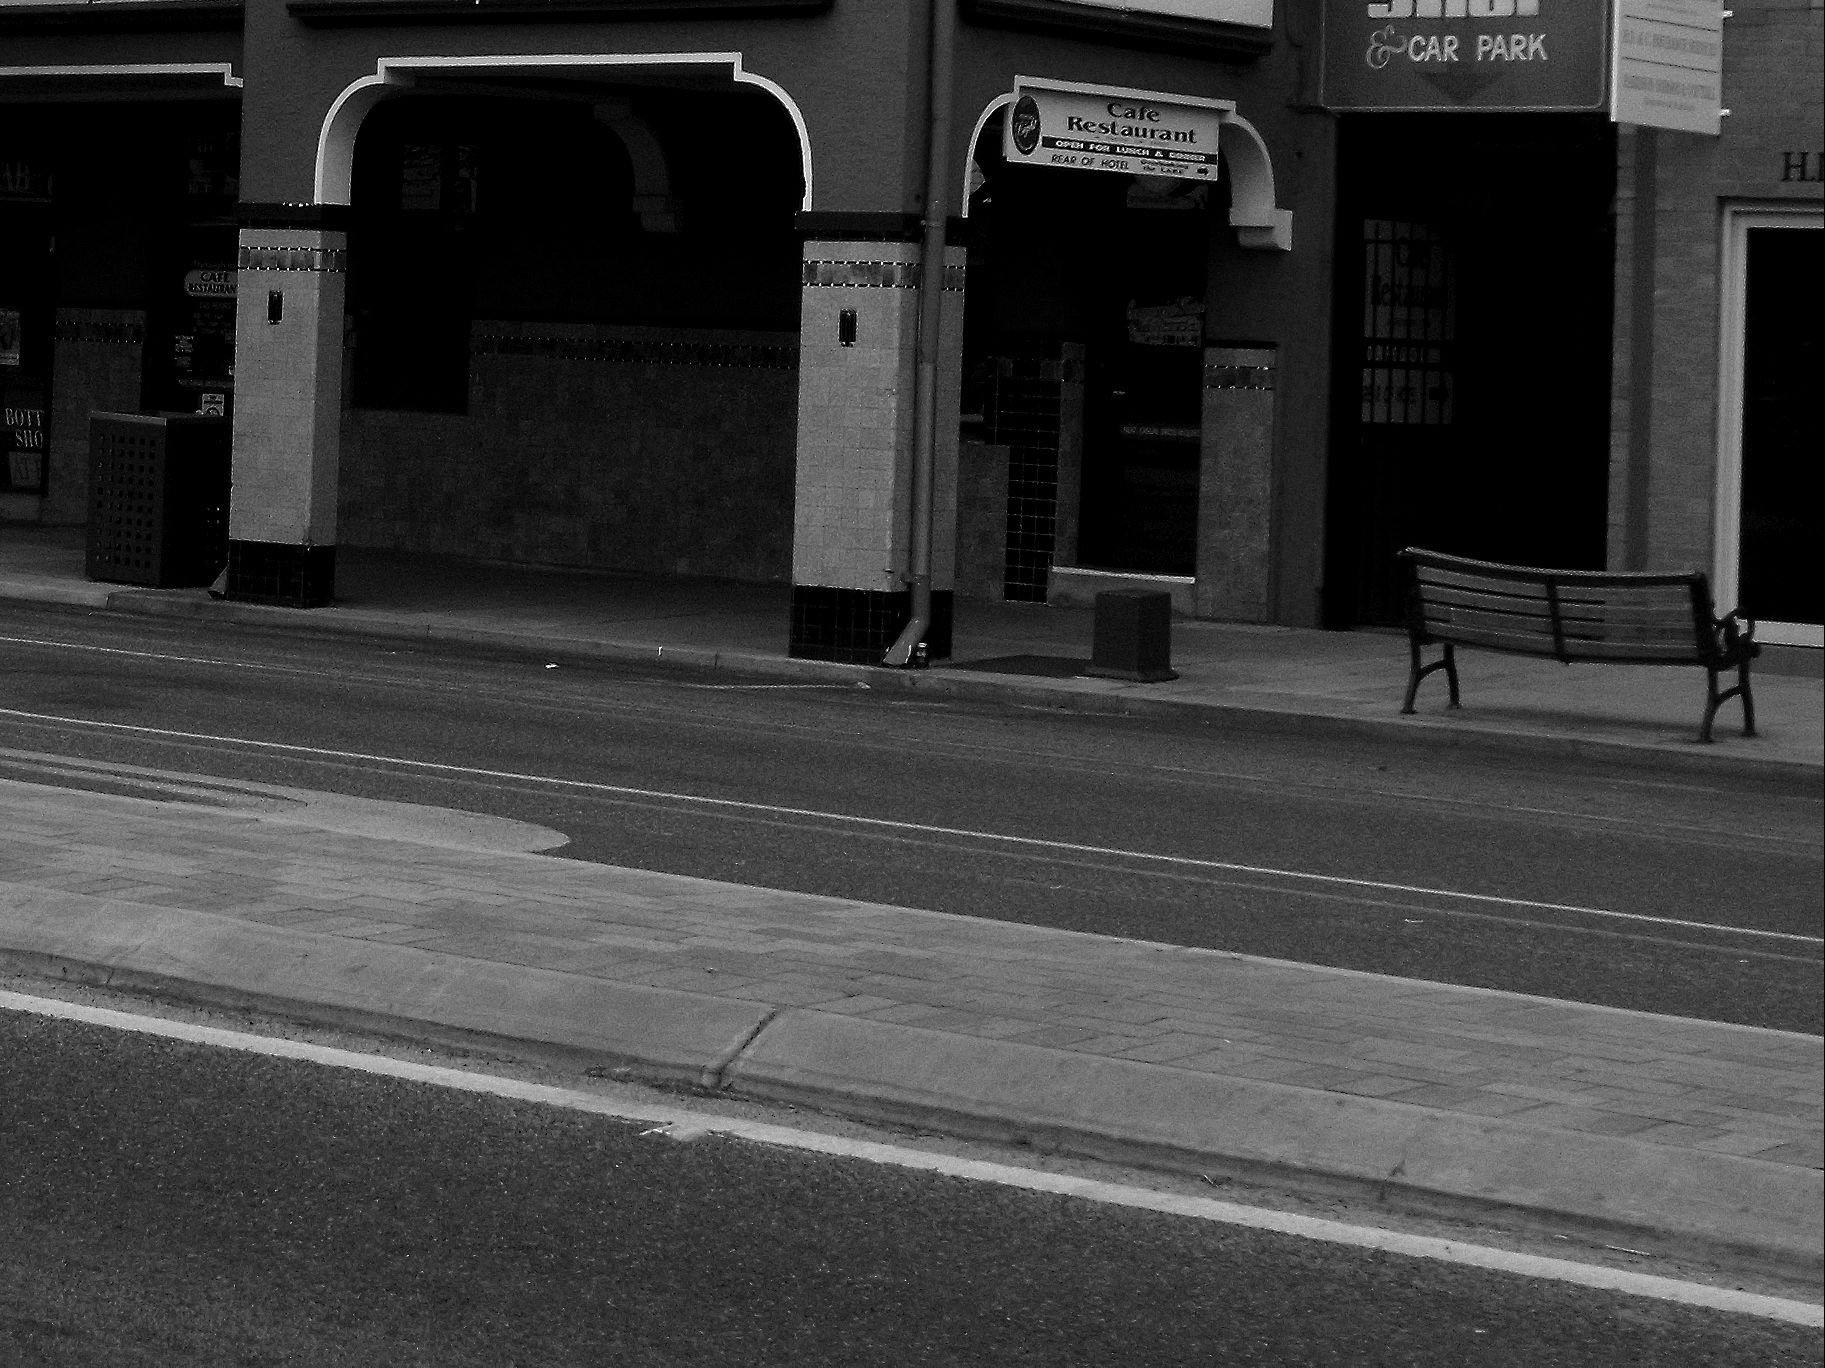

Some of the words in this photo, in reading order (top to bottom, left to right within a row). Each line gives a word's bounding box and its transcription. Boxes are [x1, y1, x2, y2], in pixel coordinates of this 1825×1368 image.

[1407, 35, 1460, 63] CAR
[1476, 33, 1549, 62] PARK
[1107, 102, 1161, 123] Cafe
[1066, 116, 1198, 144] Restaurant
[1055, 140, 1084, 150] OPEN
[1089, 143, 1111, 153] FOR
[1116, 146, 1150, 157] LUNCH
[1051, 154, 1077, 165] REAR
[1080, 156, 1095, 166] OF
[1101, 159, 1130, 170] HOTEL
[189, 283, 237, 295] RESTAURAN
[5, 407, 45, 427] BOTT
[15, 428, 44, 449] SHO
